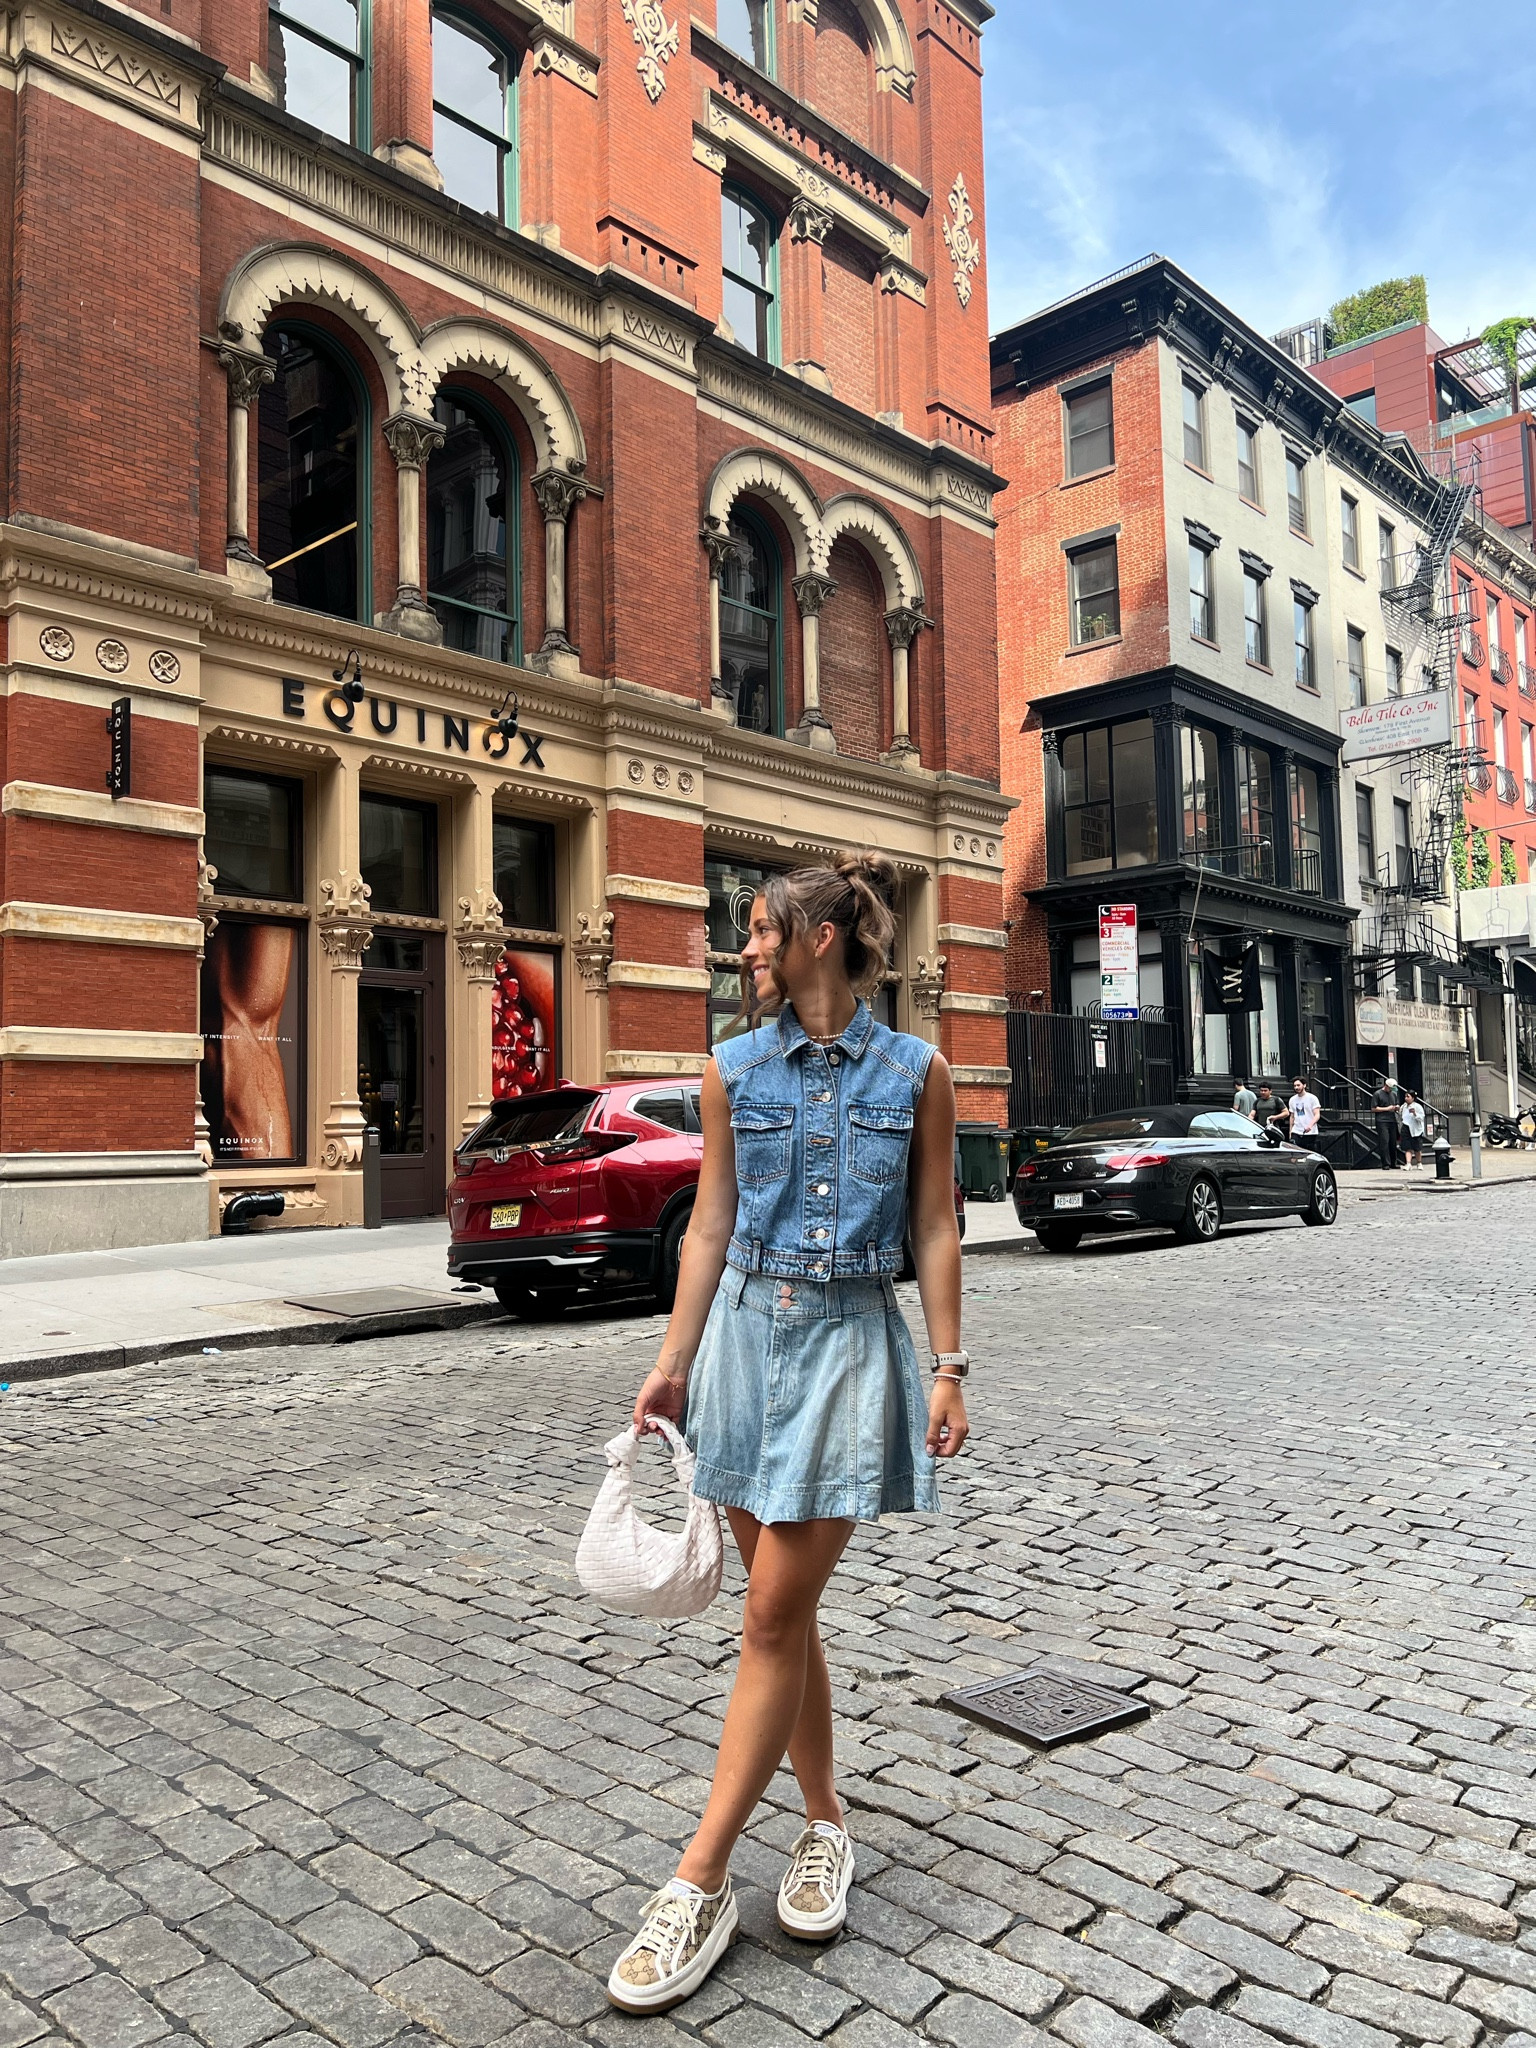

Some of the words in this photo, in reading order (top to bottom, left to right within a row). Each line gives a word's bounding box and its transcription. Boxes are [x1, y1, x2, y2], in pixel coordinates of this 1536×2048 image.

[1346, 708, 1372, 727] Bella
[1376, 703, 1397, 721] Tile
[1400, 704, 1415, 717] Co.
[1417, 700, 1439, 713] Inc
[282, 678, 545, 768] EQUINOX
[1395, 719, 1408, 728] First
[1409, 716, 1430, 724] Avenue
[1378, 742, 1394, 751] (212)
[1104, 928, 1109, 937] 3
[1104, 976, 1110, 985] 2
[1387, 1002, 1412, 1016] AMERICAN
